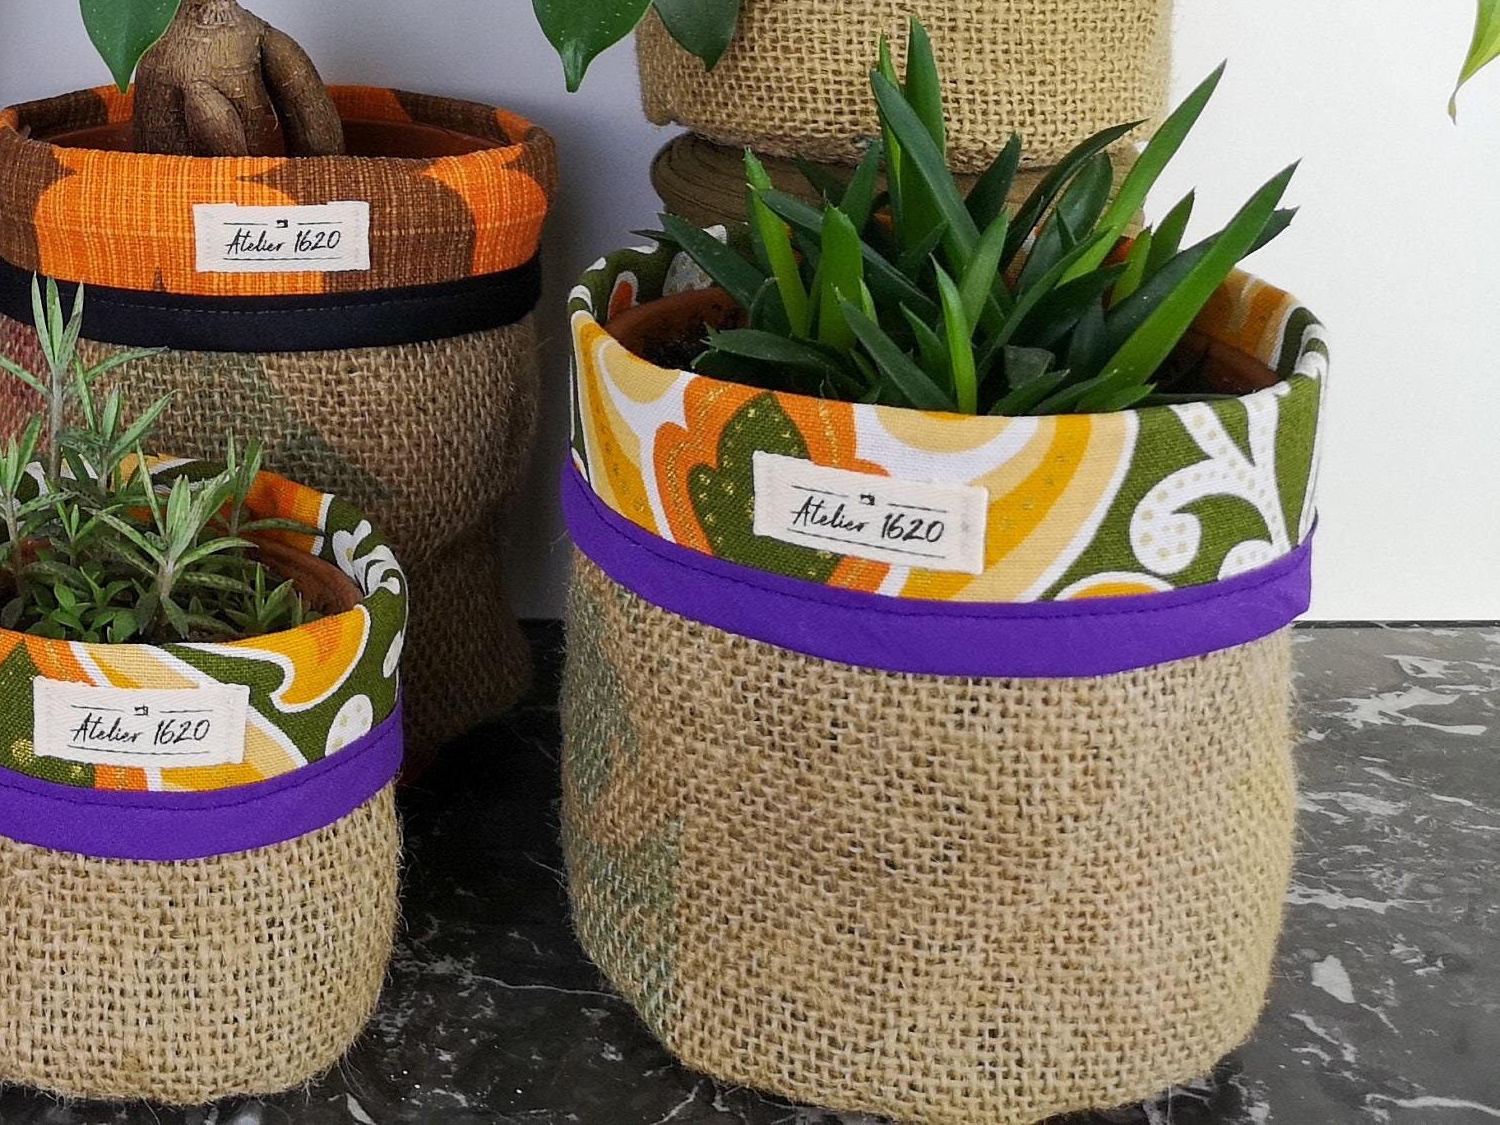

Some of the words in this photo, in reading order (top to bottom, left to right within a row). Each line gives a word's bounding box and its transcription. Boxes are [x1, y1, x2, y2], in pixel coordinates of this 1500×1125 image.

[224, 227, 287, 255] Atelier
[294, 229, 341, 253] 1620
[790, 495, 870, 532] Atelier
[880, 512, 945, 543] 1620
[70, 712, 144, 743] Atelier
[153, 718, 211, 746] 1620
